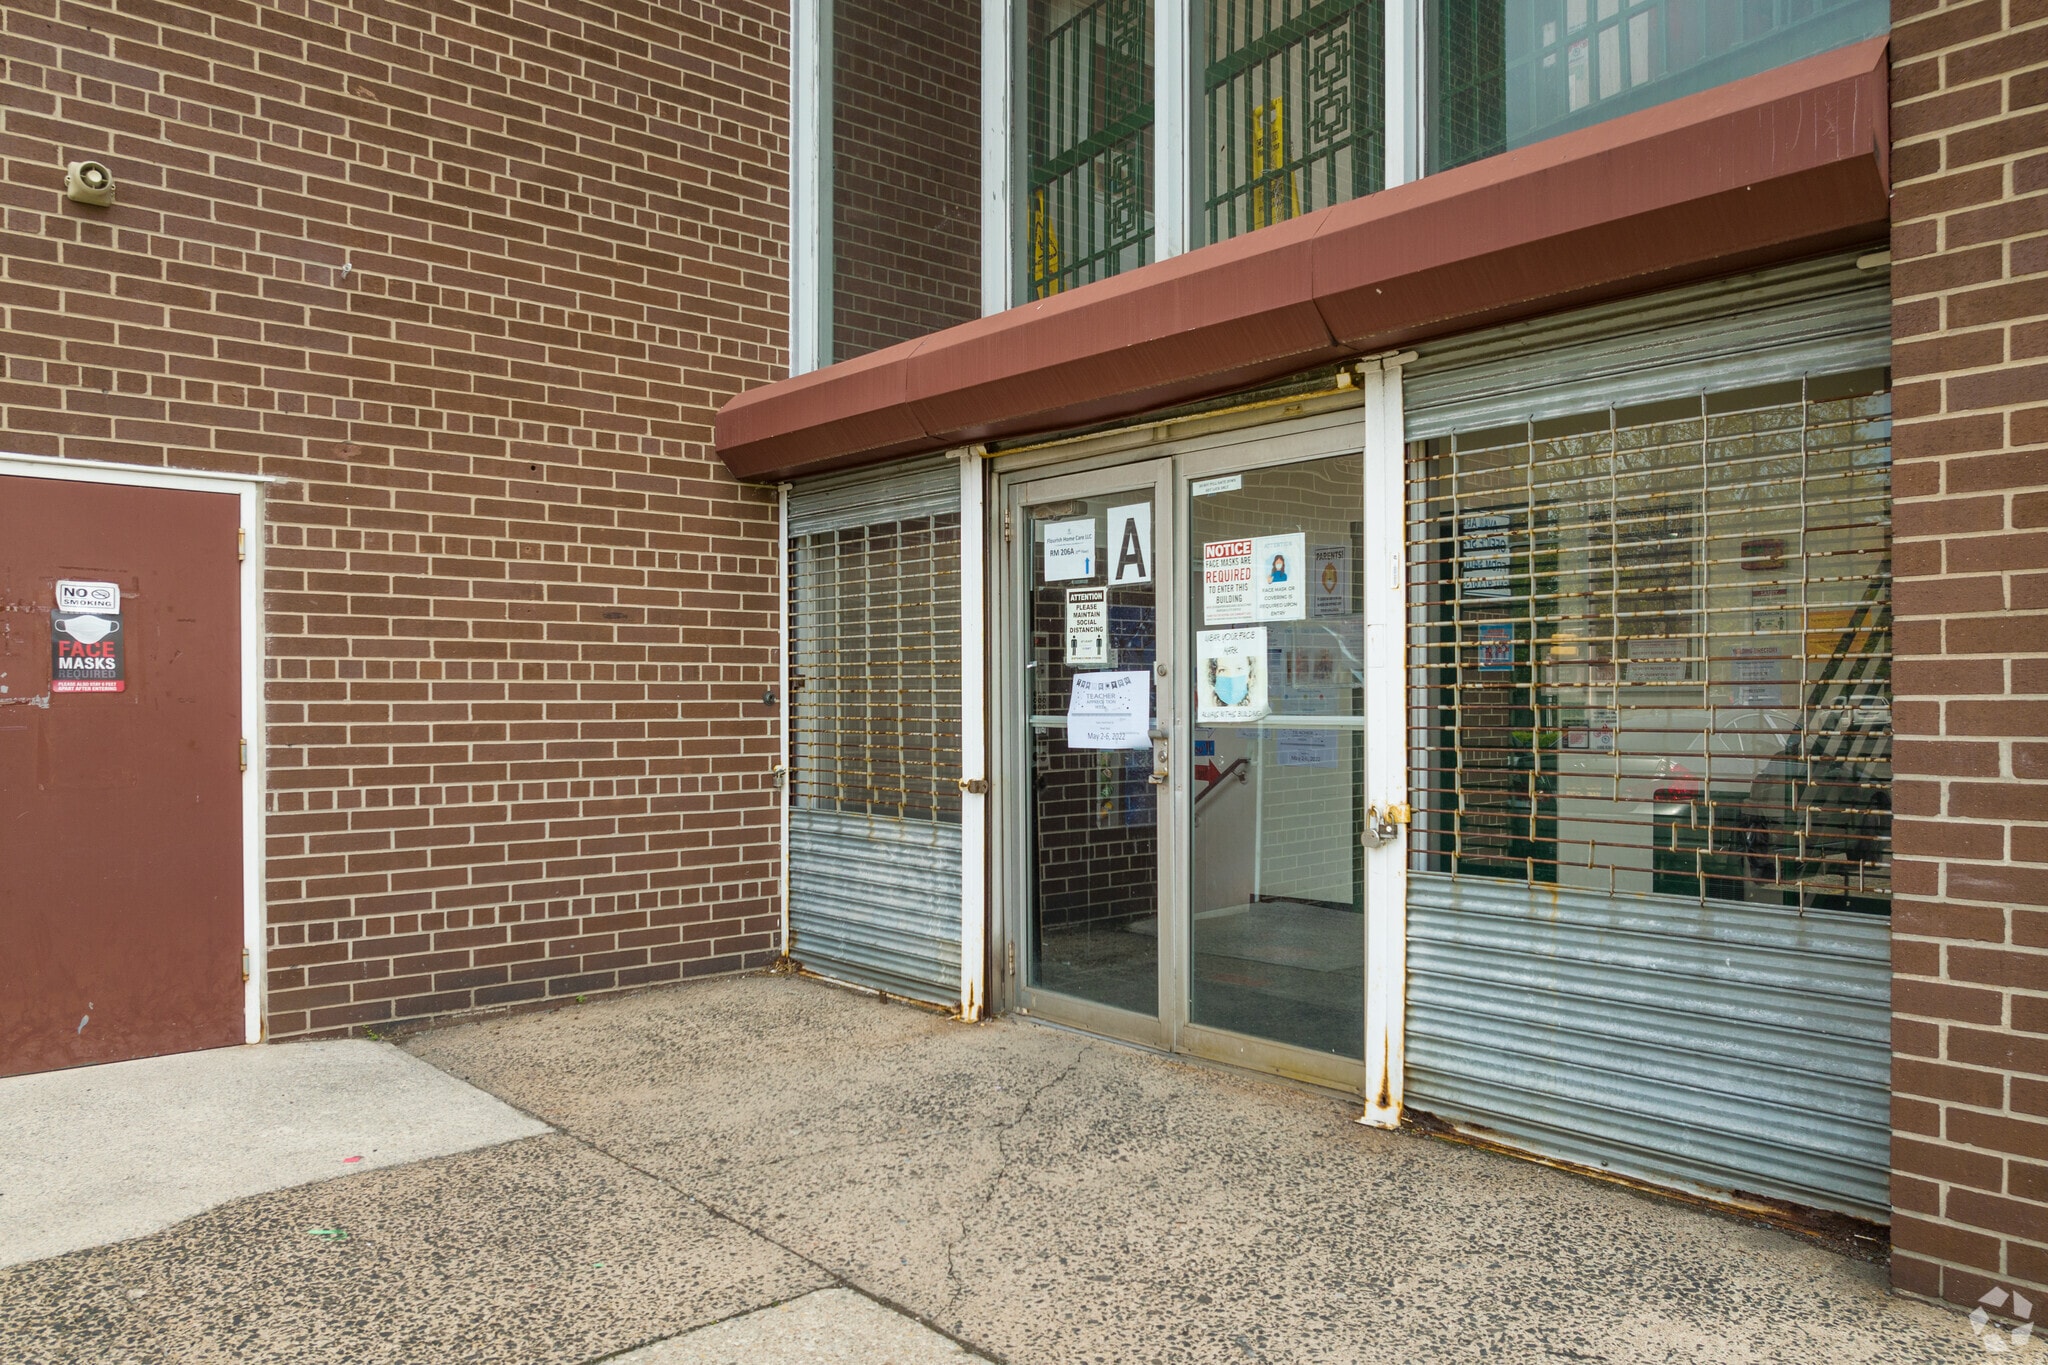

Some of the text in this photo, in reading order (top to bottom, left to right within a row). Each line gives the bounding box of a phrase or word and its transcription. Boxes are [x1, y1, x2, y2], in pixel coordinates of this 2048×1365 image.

[1050, 549, 1060, 557] RM
[1060, 547, 1075, 556] 206A
[1115, 517, 1147, 580] A
[1206, 542, 1251, 558] NOTICE
[1316, 550, 1343, 561] PARENTS!
[1206, 556, 1251, 568] FACE MASKS ARE
[1206, 567, 1251, 584] REQUIRED
[64, 587, 88, 598] NO
[1209, 583, 1248, 594] TO ENTER THIS
[63, 598, 112, 607] SMOKING
[1070, 592, 1102, 602] ATTENTION
[1216, 594, 1243, 604] BUILDING
[1069, 626, 1104, 634] DISTANCING
[58, 640, 116, 658] FACE
[59, 657, 116, 670] MASKS
[58, 669, 116, 679] REQUIRED
[1087, 732, 1126, 741] May 2-6, 2022
